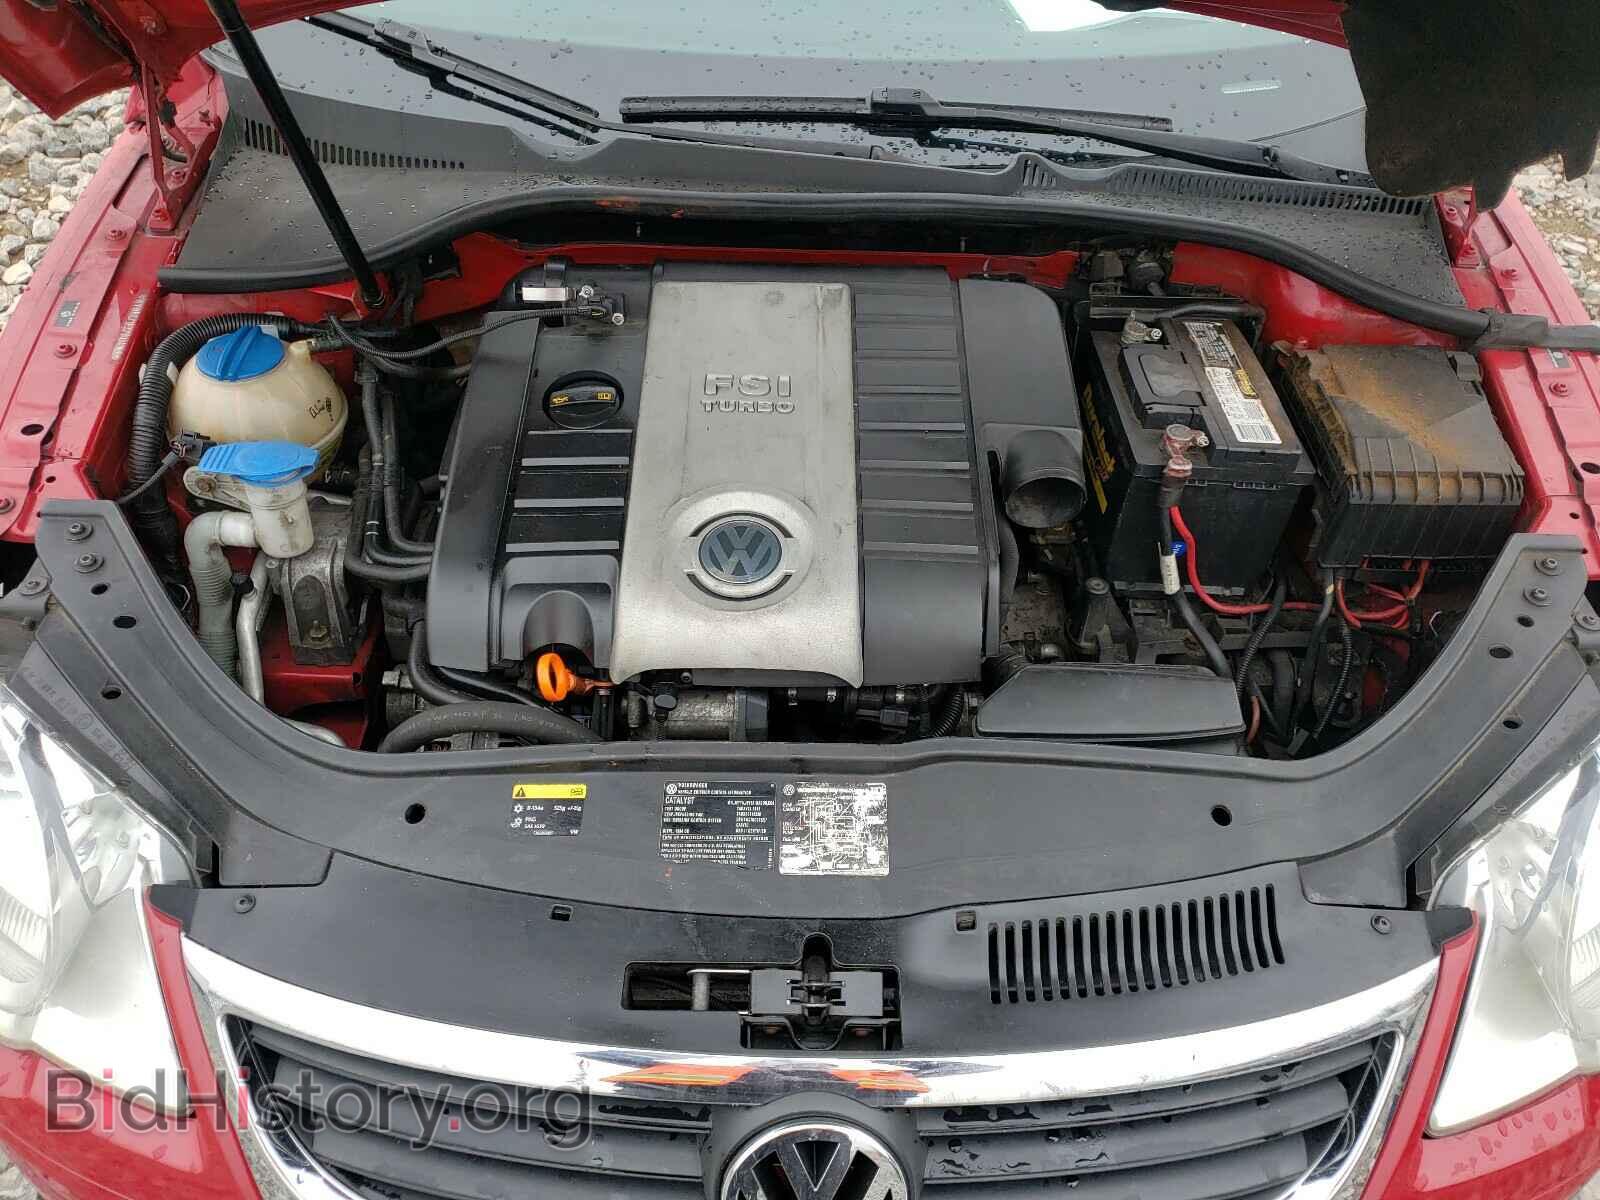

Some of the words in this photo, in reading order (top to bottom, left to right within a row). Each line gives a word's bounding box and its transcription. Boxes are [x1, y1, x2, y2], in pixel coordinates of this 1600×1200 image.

[703, 375, 791, 396] FSI
[701, 400, 795, 414] TURBO
[665, 796, 695, 805] CATALYST
